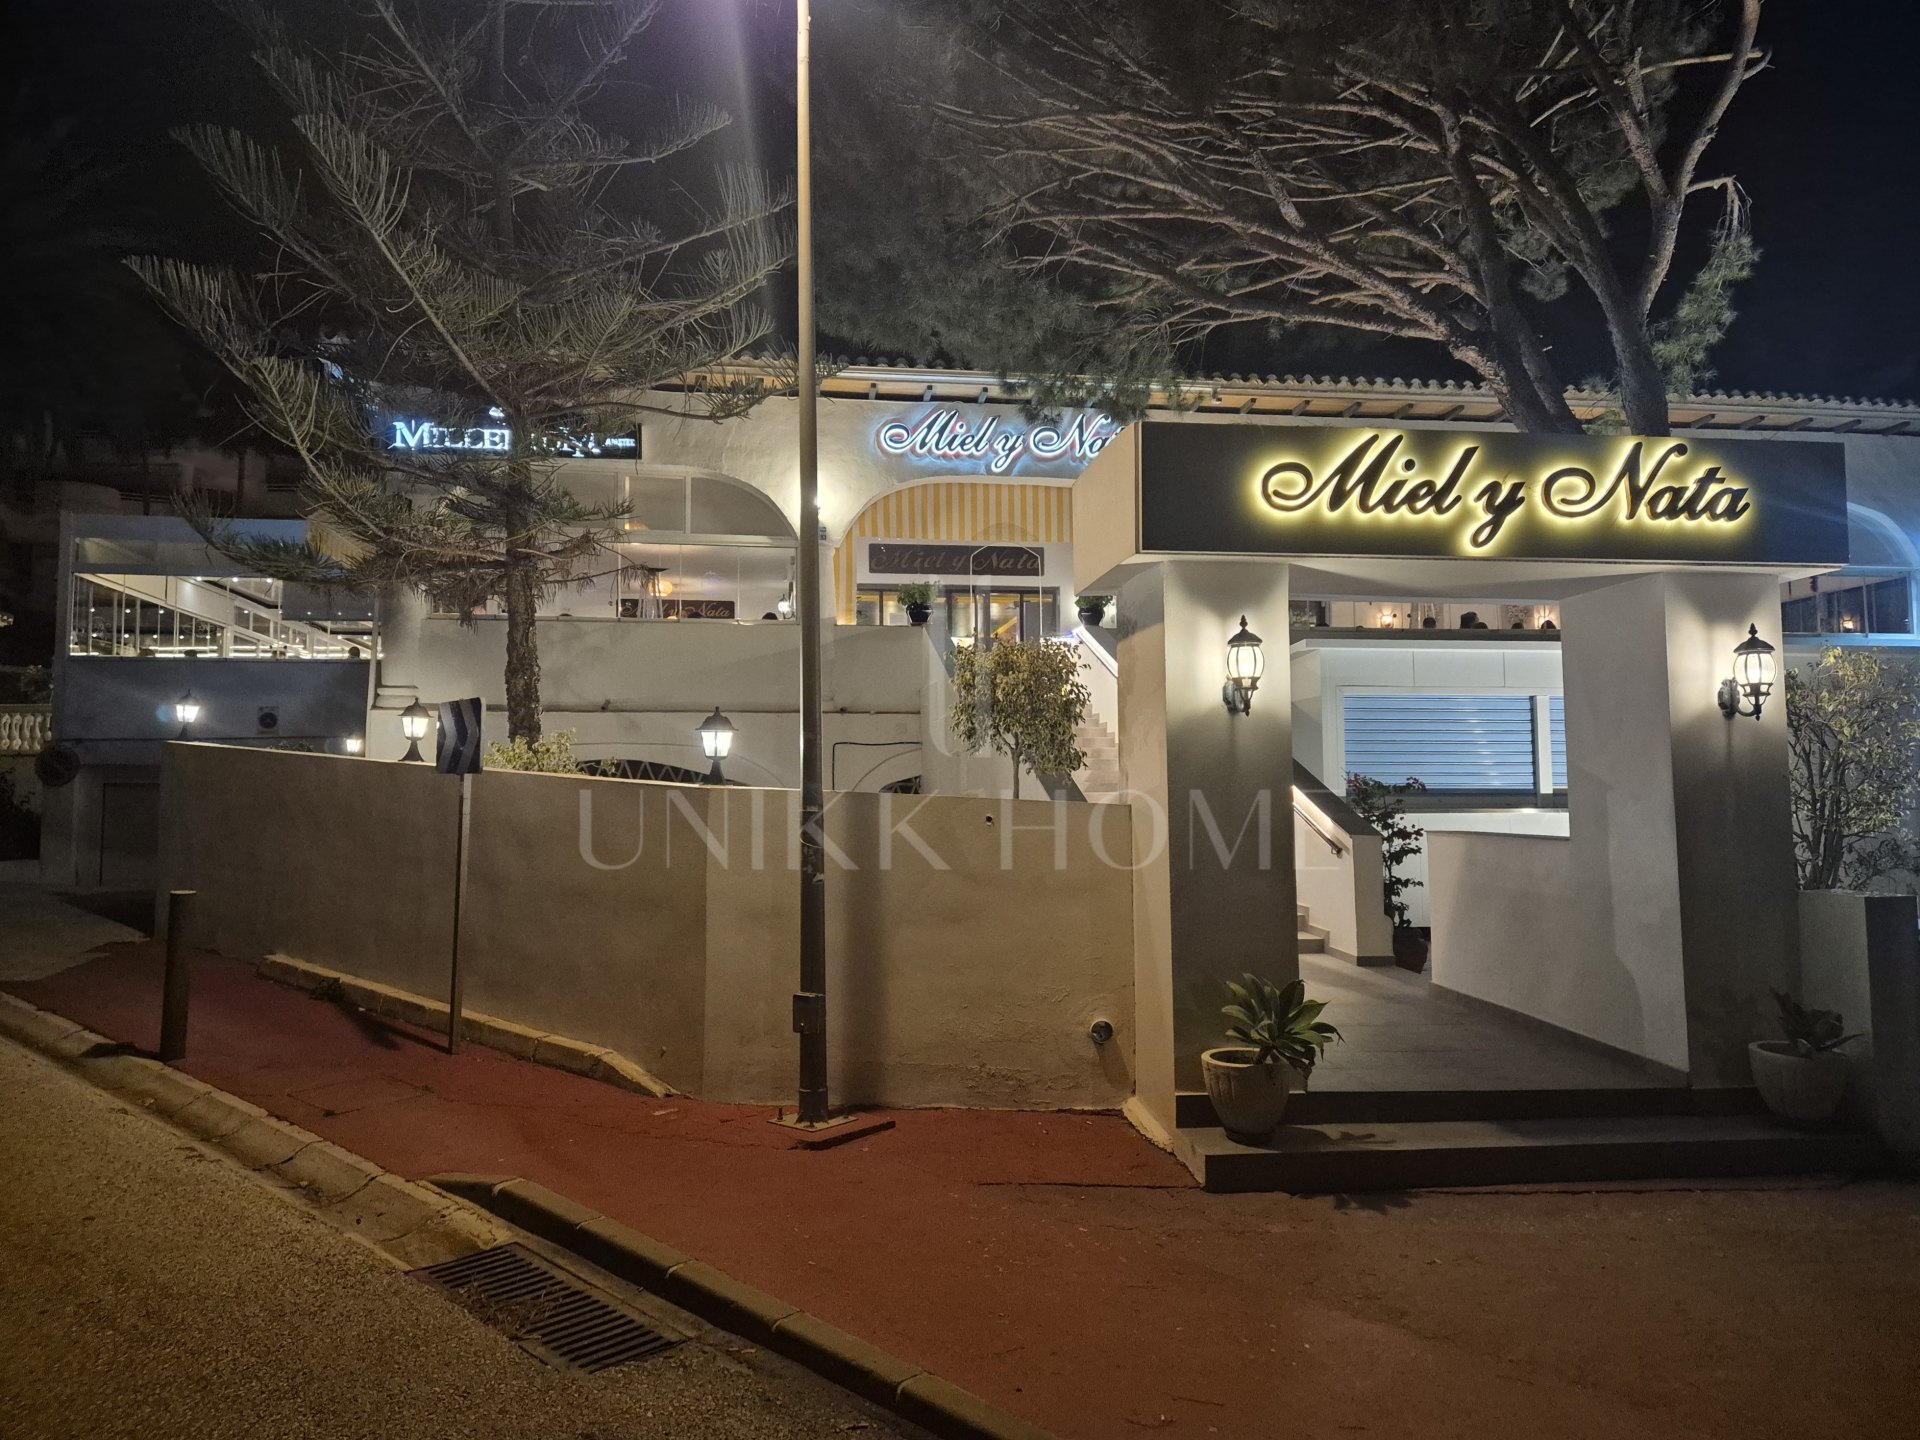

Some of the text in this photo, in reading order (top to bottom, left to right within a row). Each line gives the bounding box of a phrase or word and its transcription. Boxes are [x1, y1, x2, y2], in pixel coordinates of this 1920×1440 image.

[880, 409, 999, 455] Miel
[991, 431, 1025, 473] y
[1261, 433, 1750, 548] Miel y Nata
[871, 551, 1040, 572] Miel y Nata
